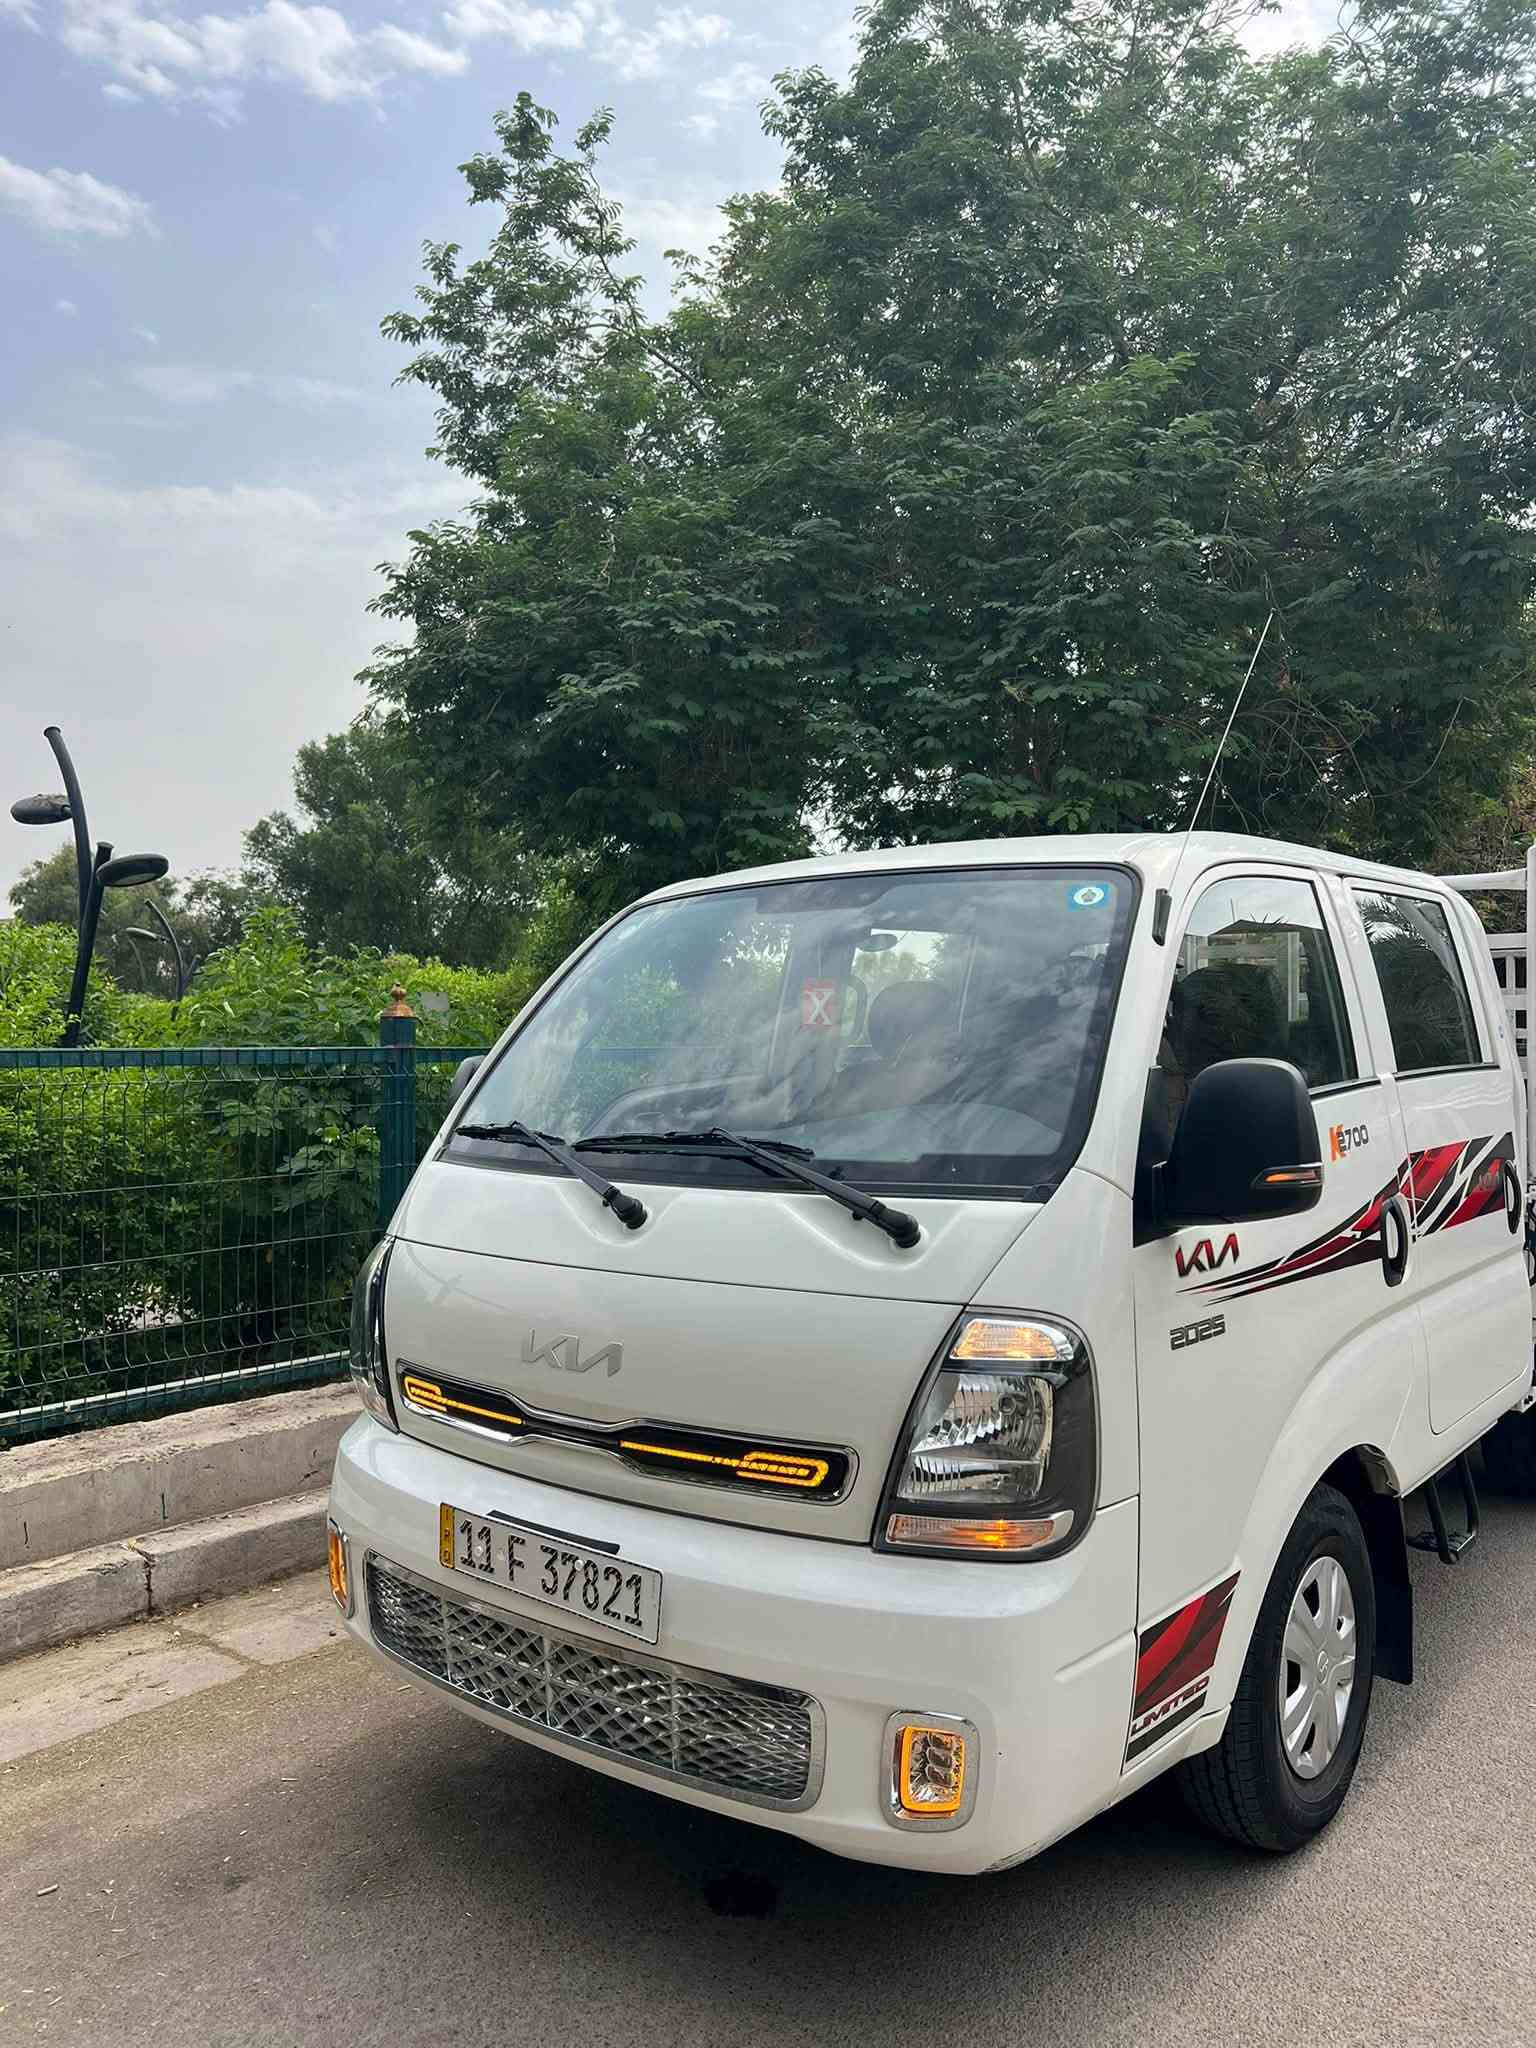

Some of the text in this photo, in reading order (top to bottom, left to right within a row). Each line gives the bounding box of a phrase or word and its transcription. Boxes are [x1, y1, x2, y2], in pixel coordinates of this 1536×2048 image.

[1175, 1233, 1240, 1278] KIA
[521, 1328, 623, 1377] KIA
[1169, 1314, 1226, 1350] 2025
[460, 1519, 643, 1627] 11 F 37821
[1131, 1675, 1210, 1737] LIMITED
